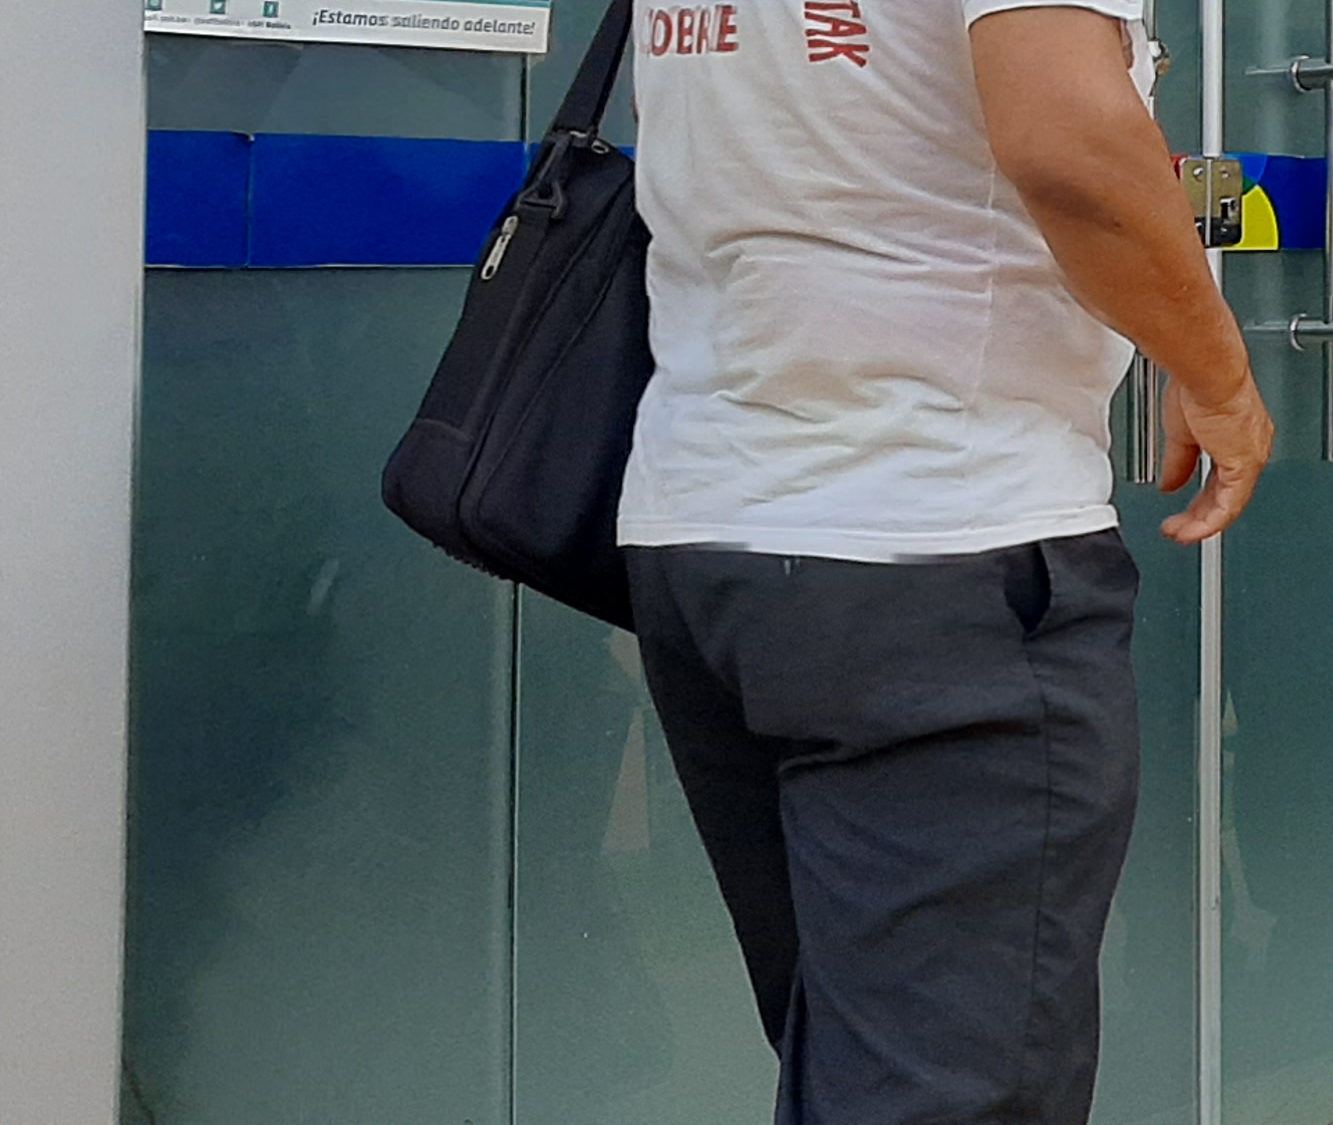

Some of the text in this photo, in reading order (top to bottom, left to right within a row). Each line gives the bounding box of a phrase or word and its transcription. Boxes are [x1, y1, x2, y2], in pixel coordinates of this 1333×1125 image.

[312, 10, 535, 34] ¡Estamos saliendo adelante!
